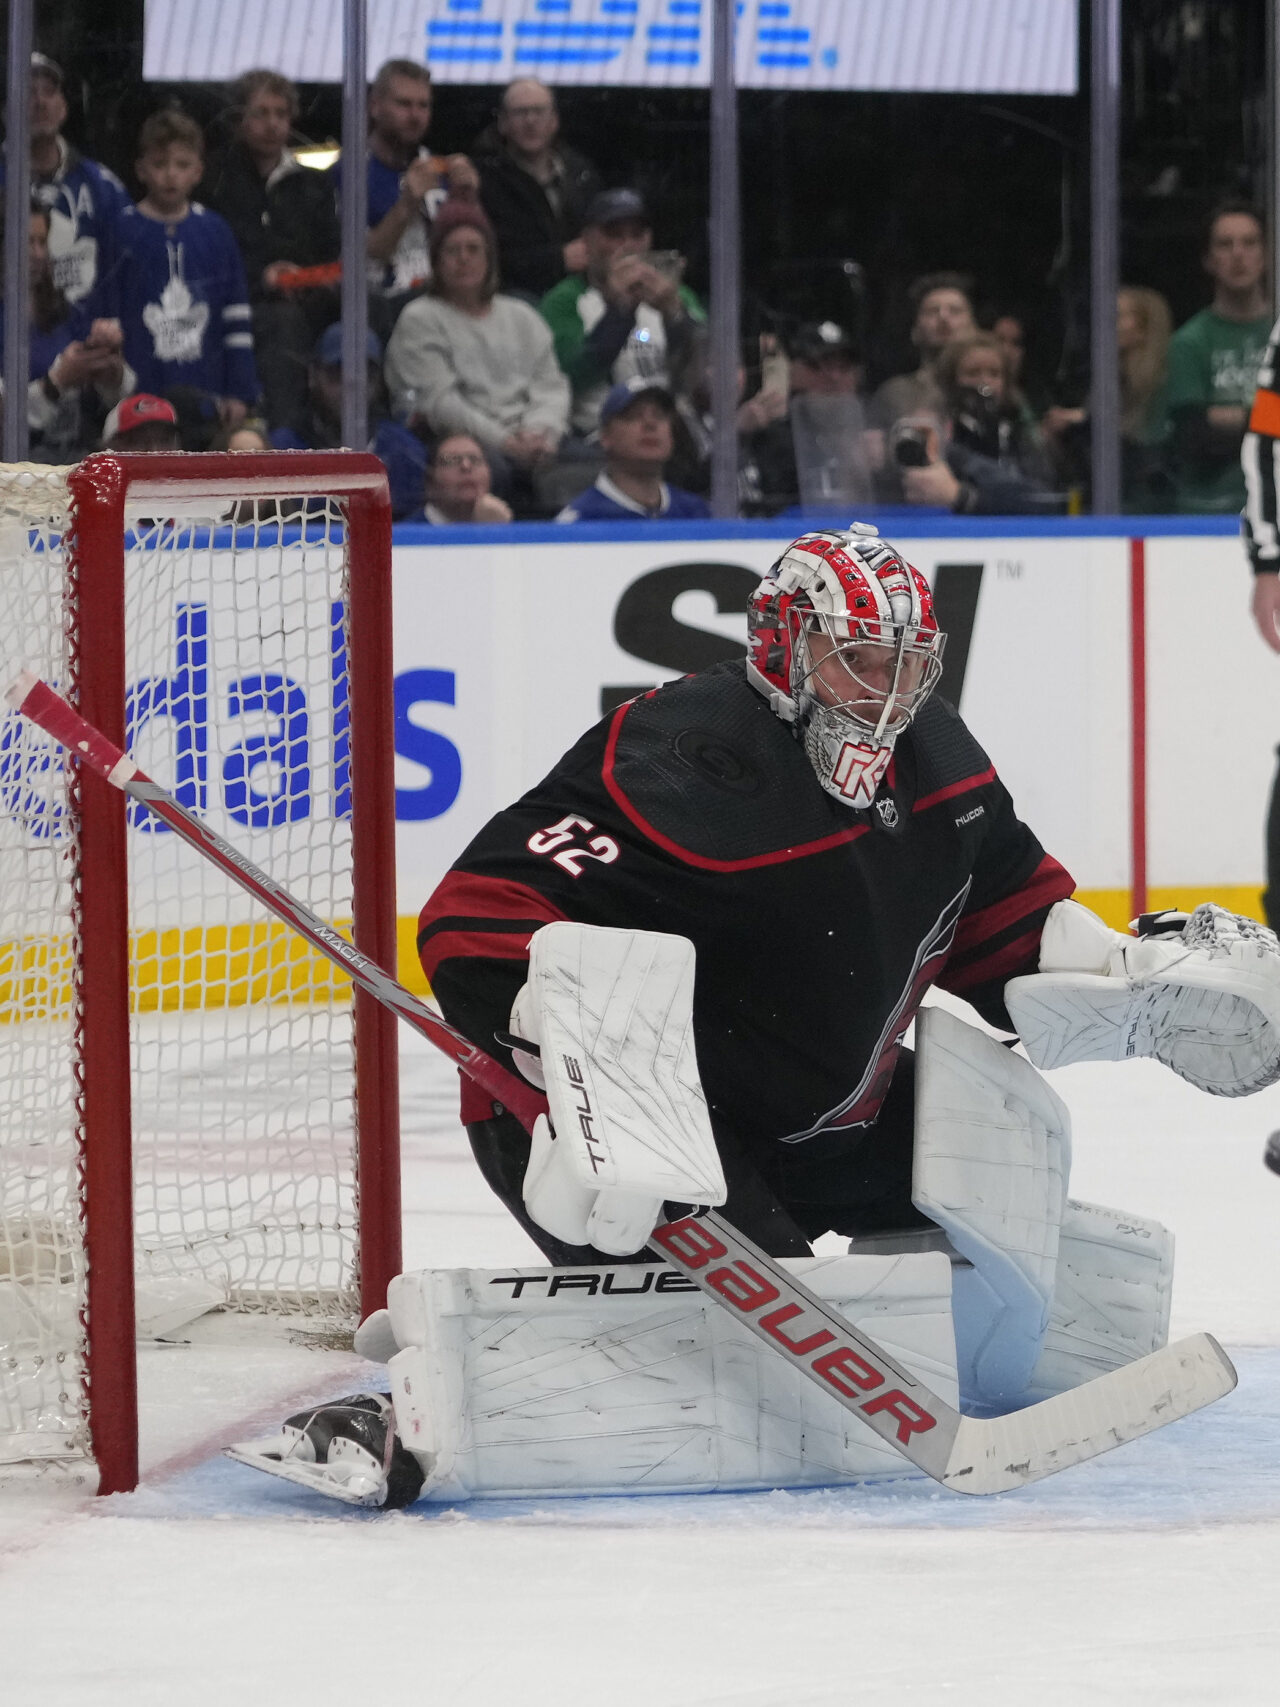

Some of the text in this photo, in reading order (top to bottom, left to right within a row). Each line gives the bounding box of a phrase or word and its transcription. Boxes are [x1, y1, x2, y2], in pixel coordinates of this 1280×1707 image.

[954, 805, 986, 828] NUCOR
[526, 812, 621, 879] 52
[313, 925, 369, 969] MACH
[1125, 1010, 1142, 1057] TRUE
[562, 1053, 607, 1176] TRUE
[488, 1270, 702, 1299] TRUE
[651, 1217, 938, 1447] BAUER
